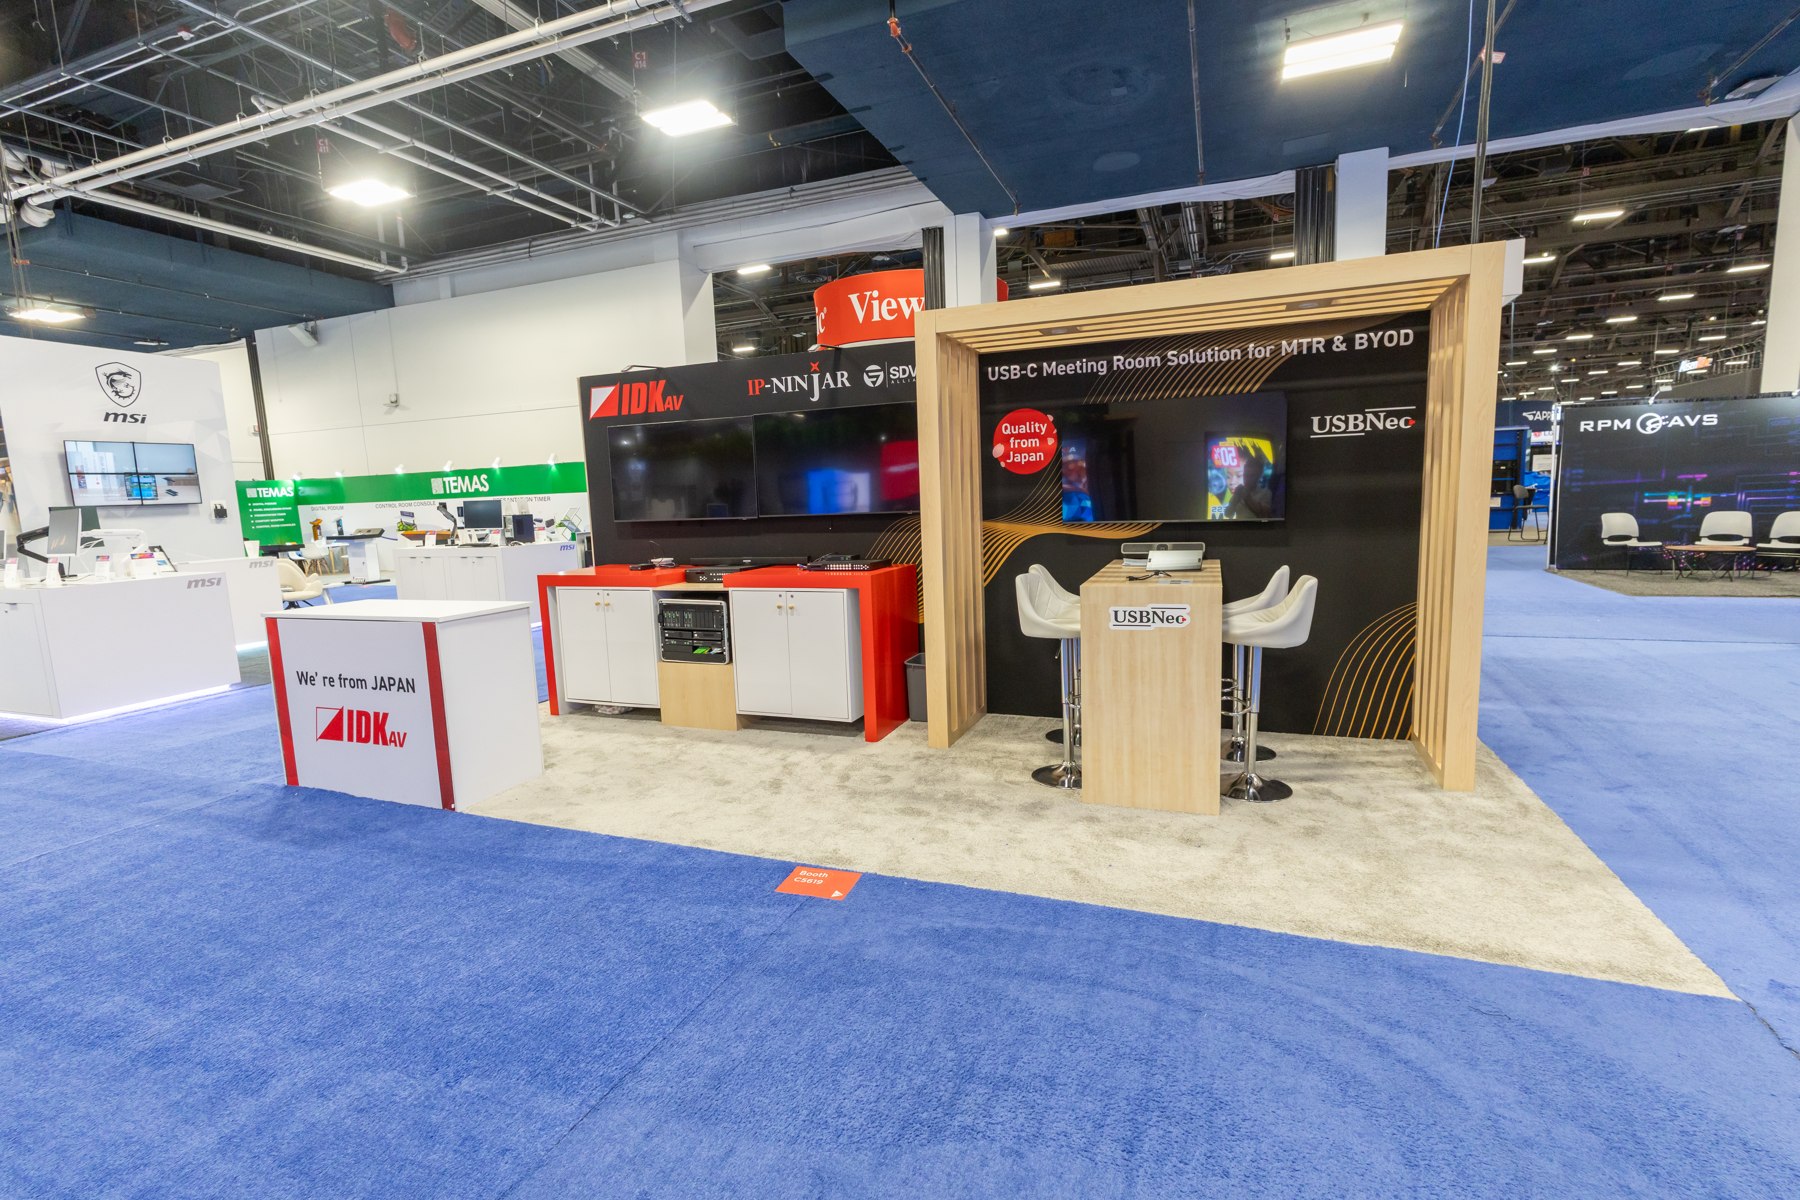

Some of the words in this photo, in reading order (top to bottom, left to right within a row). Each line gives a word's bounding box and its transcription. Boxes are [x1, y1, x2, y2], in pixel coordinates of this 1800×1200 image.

[987, 362, 1038, 381] USB-C
[1042, 358, 1108, 376] Meeting
[1113, 354, 1161, 371] Room
[1167, 346, 1242, 366] Solution
[1247, 343, 1275, 360] for
[1281, 337, 1325, 356] MTR
[1331, 335, 1348, 351] &
[1354, 328, 1414, 350] BYOD
[103, 411, 147, 424] msi
[1579, 418, 1631, 432] RPM
[1667, 413, 1719, 427] AVS
[1001, 421, 1047, 435] Quality
[1009, 436, 1040, 448] from
[1006, 451, 1044, 465] Japan
[442, 473, 490, 494] TEMAS
[256, 486, 294, 498] TEMAS
[248, 560, 274, 569] msi
[186, 577, 222, 589] msi
[338, 673, 368, 690] from
[371, 675, 416, 694] JAPAN
[793, 876, 824, 885] C5619
[799, 870, 829, 878] Booth
